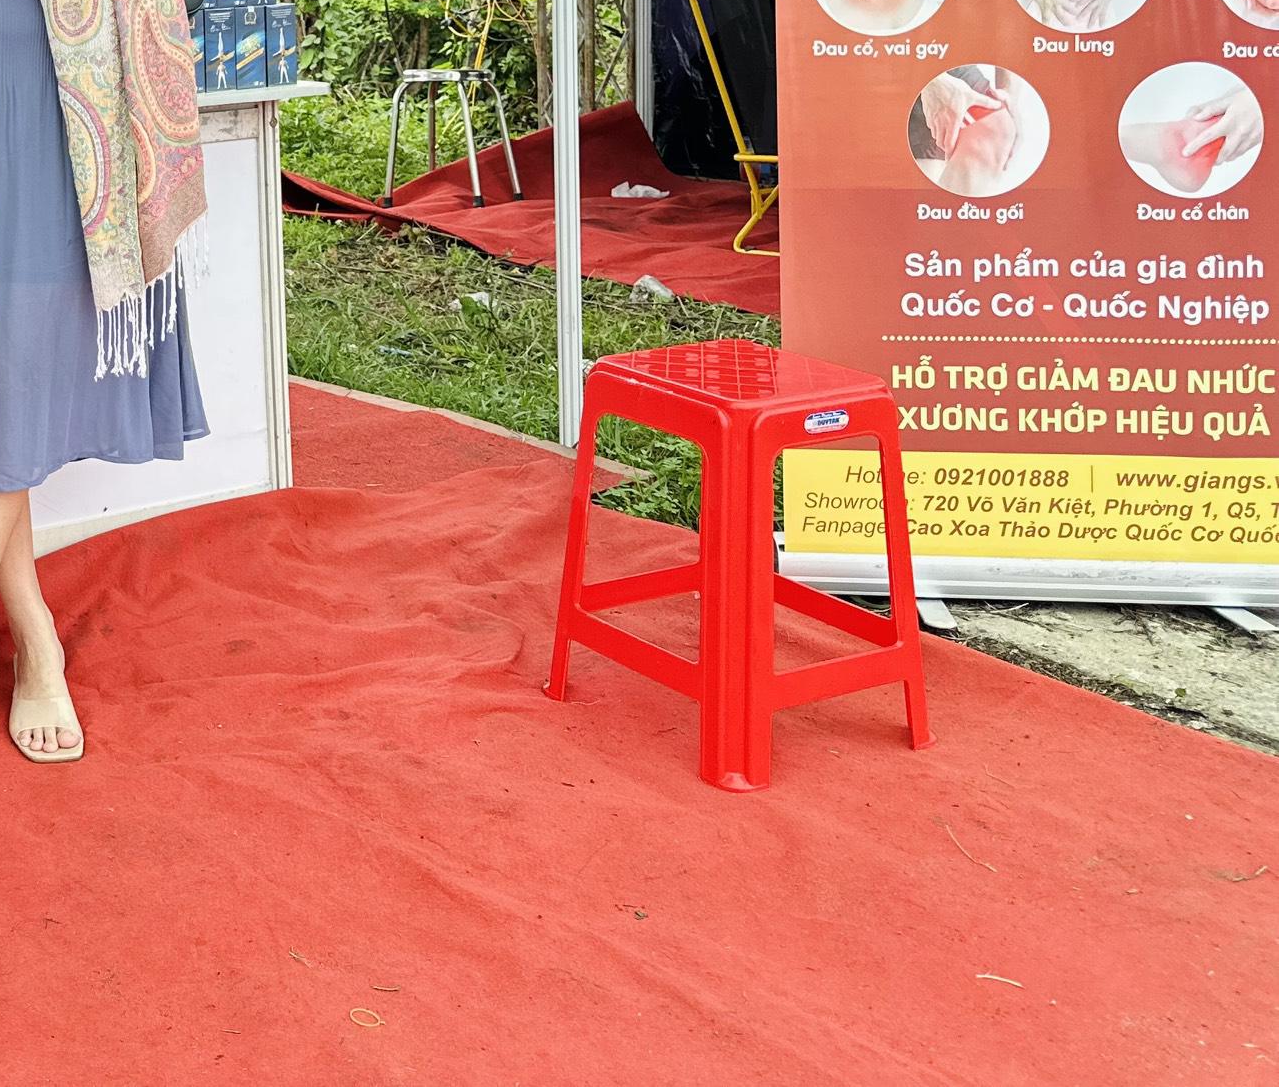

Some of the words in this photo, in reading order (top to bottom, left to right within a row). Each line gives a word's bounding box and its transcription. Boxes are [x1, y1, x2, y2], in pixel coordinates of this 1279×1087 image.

[812, 40, 848, 57] Đau
[853, 39, 879, 59] cổ,
[884, 41, 911, 57] vai
[915, 41, 949, 60] gáy
[1033, 37, 1070, 54] Đau
[1073, 35, 1115, 57] lưng
[1222, 41, 1258, 58] Đau
[917, 204, 954, 221] Đau
[957, 200, 993, 221] đầu
[996, 202, 1024, 224] gối
[1137, 203, 1176, 221] Đau
[1181, 201, 1203, 222] cổ
[1207, 203, 1249, 221] chân
[904, 249, 962, 277] Sản
[973, 247, 1059, 283] phẩm
[1069, 251, 1126, 278] của
[1137, 254, 1187, 284] gia
[1197, 253, 1264, 279] đình
[900, 289, 980, 319] Quốc
[990, 292, 1035, 317] Cơ
[1063, 291, 1147, 319] Quốc
[1158, 294, 1270, 326] Nghiệp
[891, 354, 935, 389] HỖ
[943, 363, 1008, 396] TRỢ
[1016, 358, 1099, 391] GIẢM
[1108, 367, 1177, 393] ĐAU
[1186, 363, 1277, 394] NHỨC
[898, 403, 1009, 432] XƯƠNG
[1018, 401, 1107, 433] KHỚP
[1115, 404, 1193, 441] HIỆU
[1202, 403, 1271, 442] QUẢ
[845, 465, 926, 485] Hote:
[933, 468, 1069, 488] 0921001888
[923, 495, 959, 512] 720
[967, 495, 993, 512] Võ
[1002, 495, 1041, 514] Văn
[1048, 497, 1096, 518] Kiệt,
[1104, 498, 1193, 521] Phường
[1202, 501, 1218, 521] 1,
[1227, 502, 1261, 522] Q5,
[907, 518, 943, 536] Cao
[949, 519, 990, 537] Xoa
[999, 520, 1050, 539] Thảo
[1057, 522, 1118, 543] Dược
[1125, 522, 1183, 542] Quốc
[1191, 525, 1224, 542] Cơ
